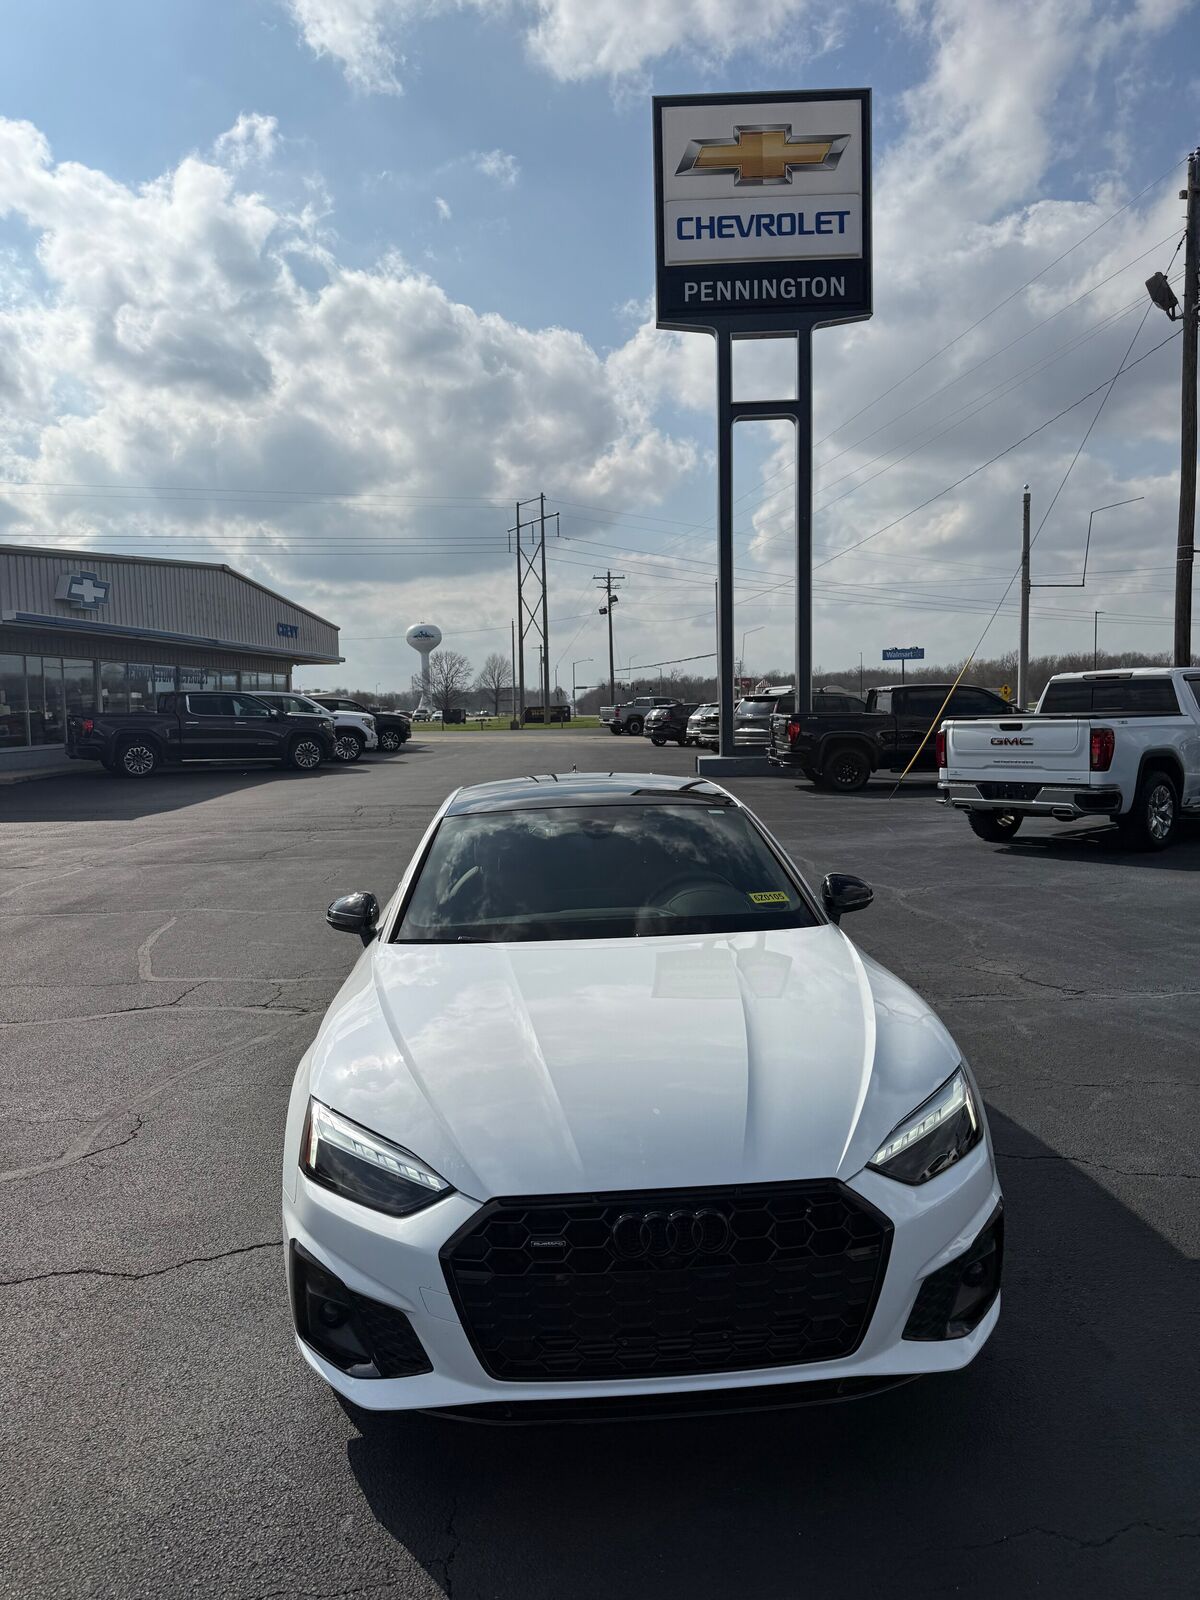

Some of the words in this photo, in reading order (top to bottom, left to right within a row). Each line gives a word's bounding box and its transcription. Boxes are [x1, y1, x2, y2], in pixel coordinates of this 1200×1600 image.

[676, 211, 850, 240] CHEVROLET
[684, 276, 845, 302] PENNINGTON
[886, 650, 913, 659] Walmart
[990, 737, 1034, 746] GMC
[753, 892, 785, 901] 6Z0105
